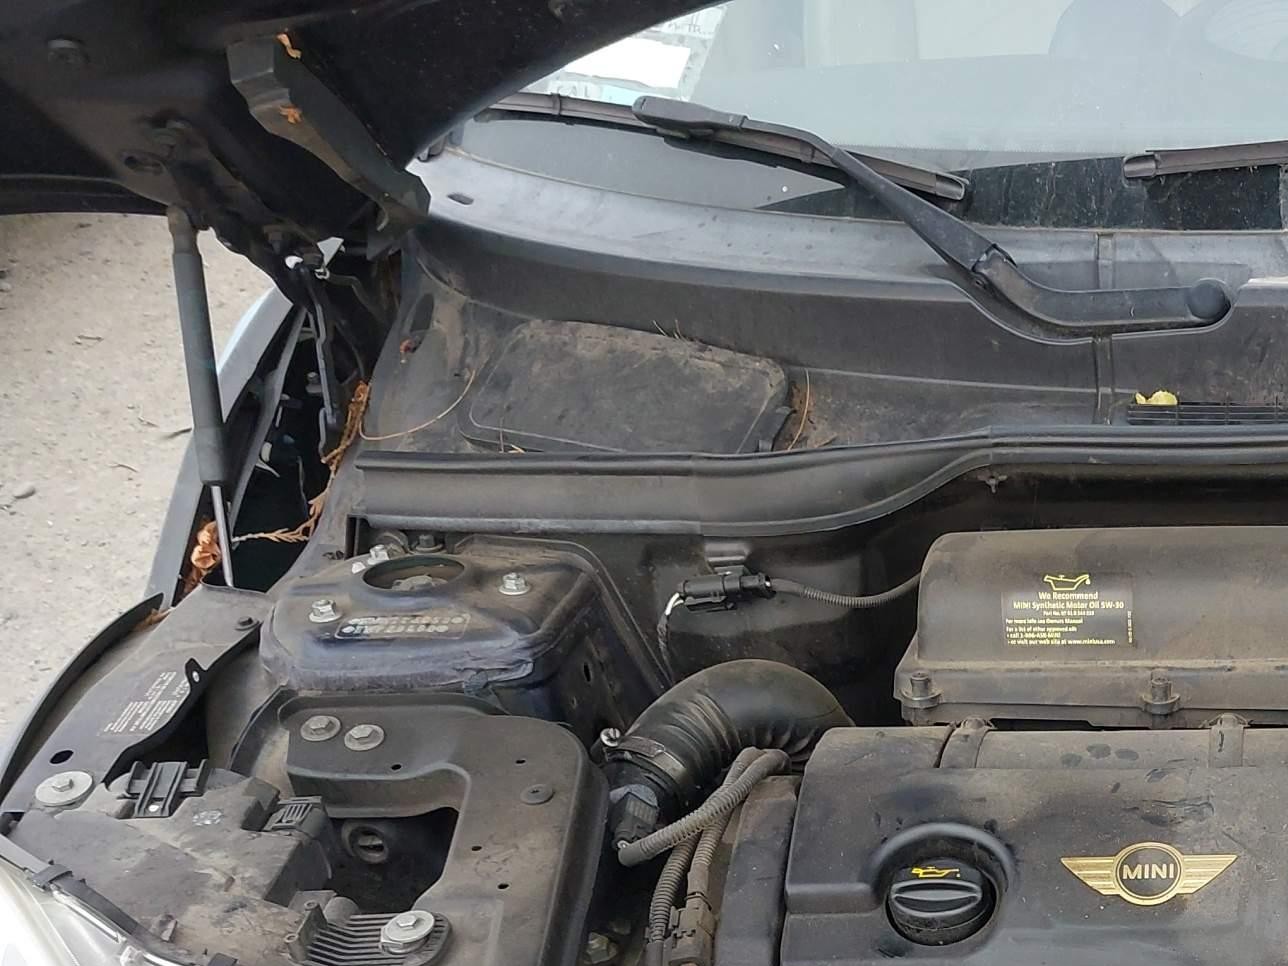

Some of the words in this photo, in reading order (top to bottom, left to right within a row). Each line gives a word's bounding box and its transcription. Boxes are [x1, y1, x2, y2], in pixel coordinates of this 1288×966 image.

[1039, 592, 1052, 600] We
[1052, 592, 1098, 600] Recommend
[1013, 601, 1031, 609] MINI
[1032, 601, 1065, 611] Synthetic
[1066, 601, 1088, 609] Motor
[1089, 601, 1100, 609] Oil
[1101, 601, 1125, 609] 5W-30
[1122, 863, 1175, 879] MINI
